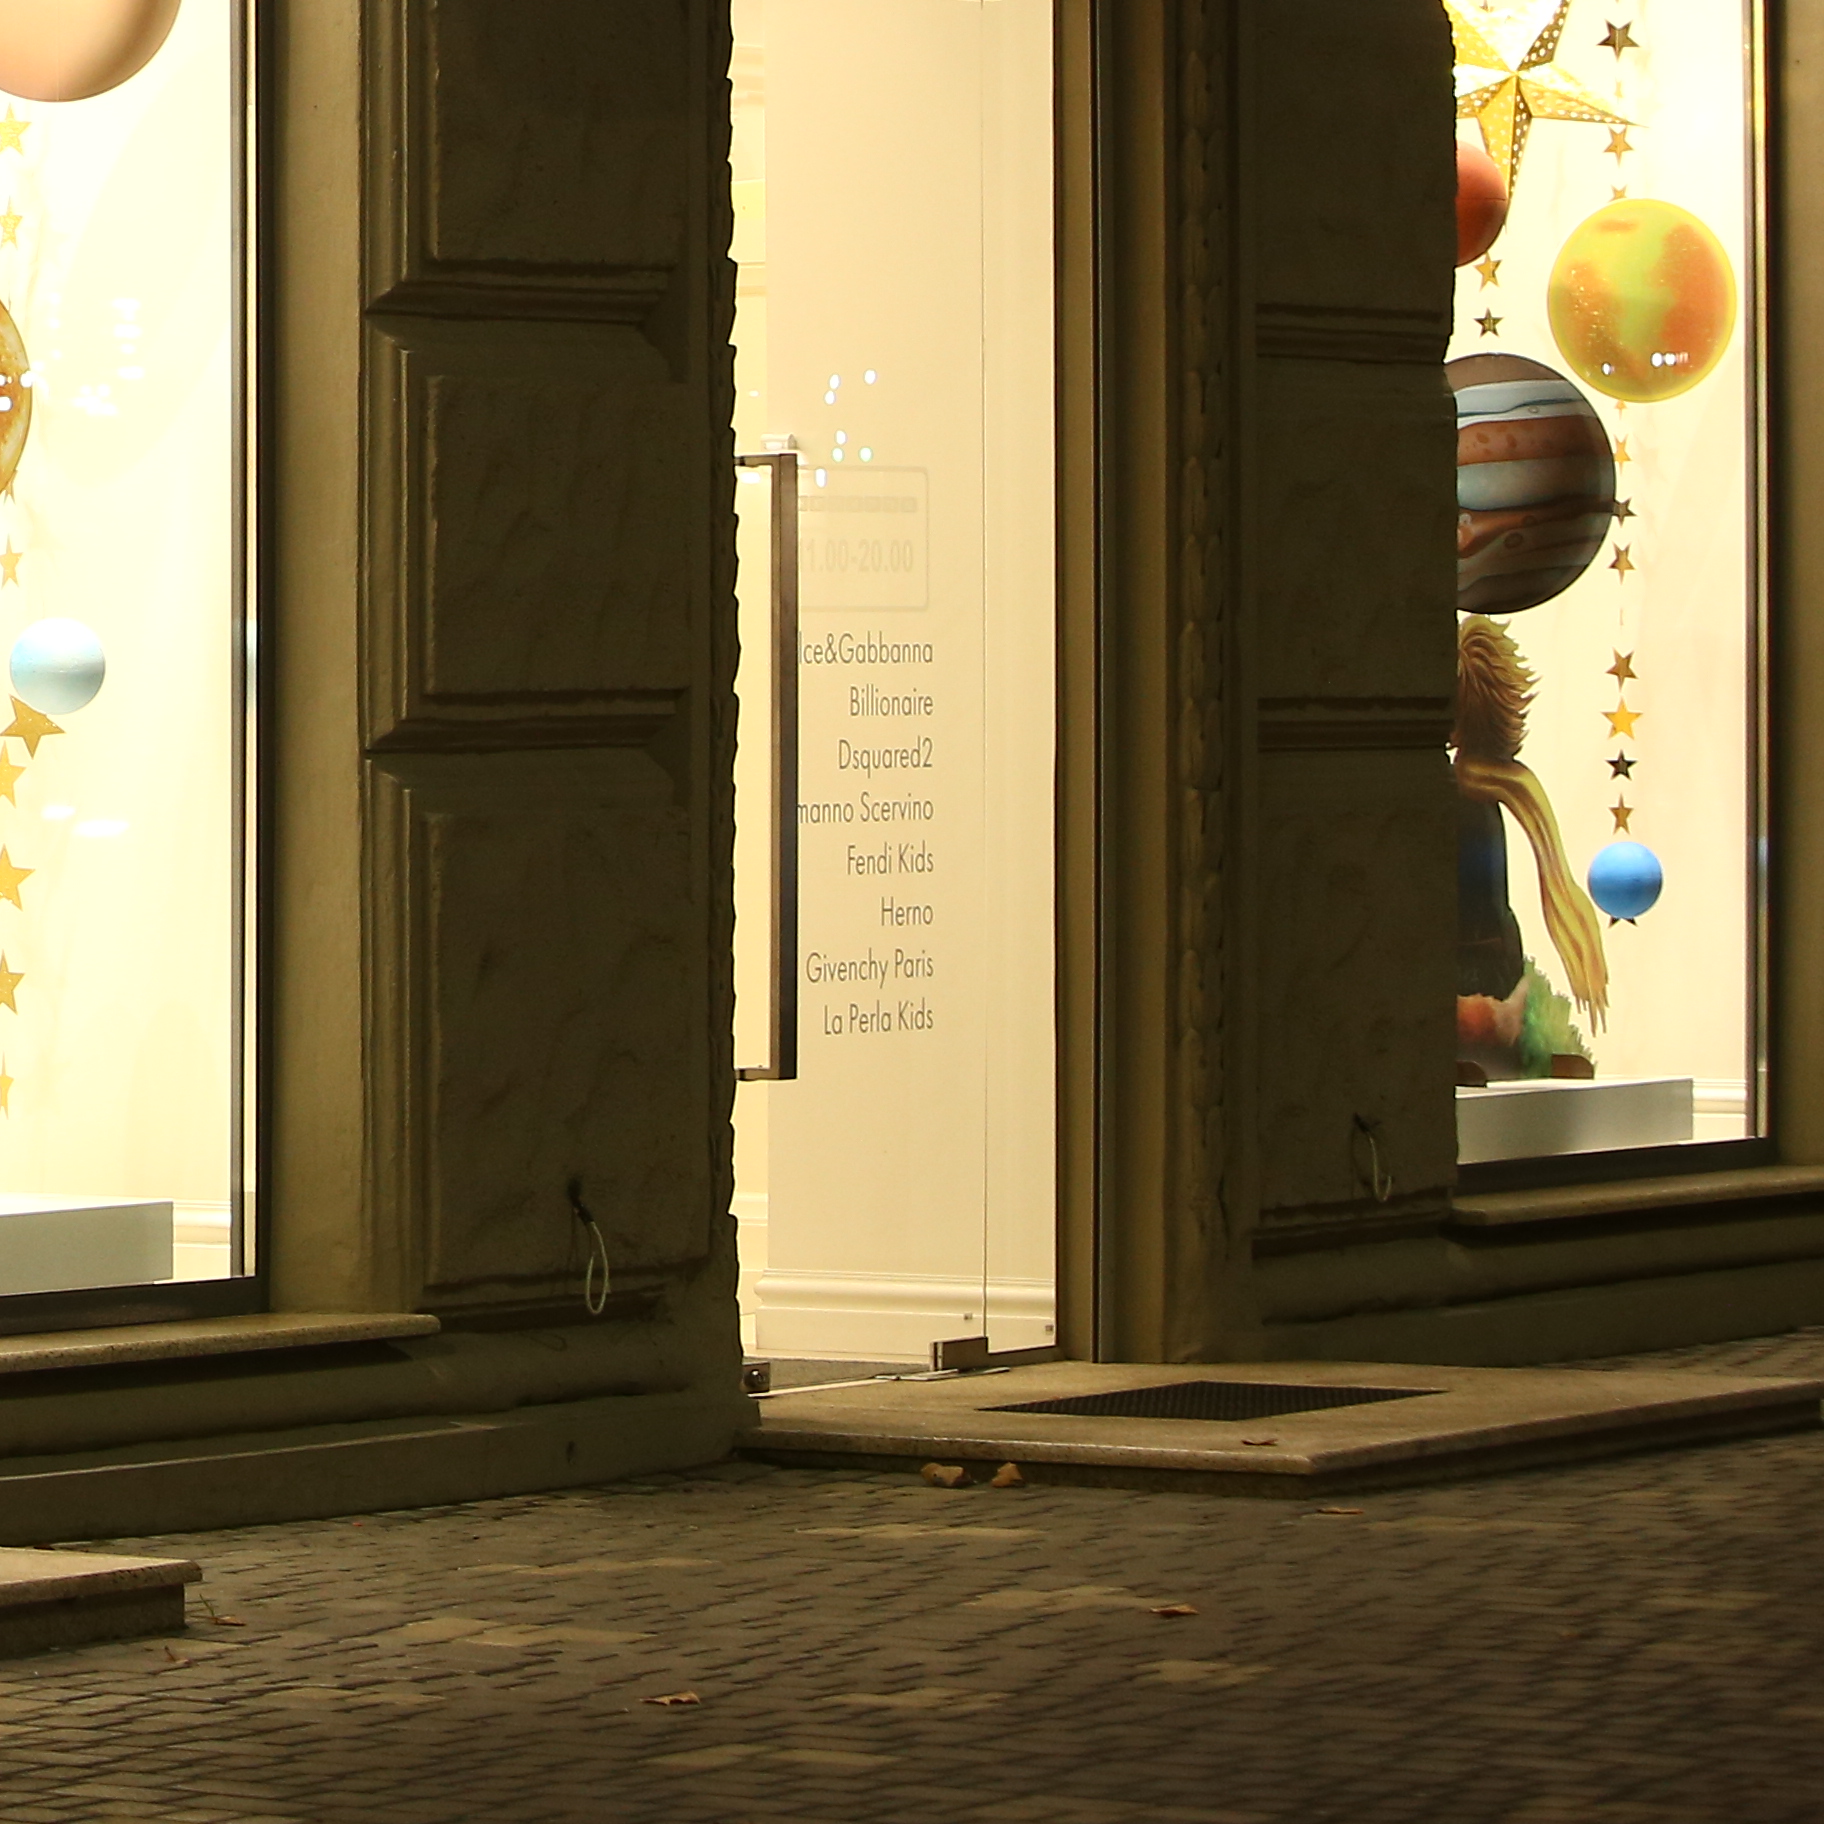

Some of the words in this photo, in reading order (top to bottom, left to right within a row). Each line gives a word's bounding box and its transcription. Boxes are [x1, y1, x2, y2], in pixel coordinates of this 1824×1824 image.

[850, 683, 933, 717] Billionaire
[838, 735, 933, 779] Dsquared2
[860, 791, 934, 822] Scervino
[847, 841, 892, 875] Fendi
[898, 839, 934, 874] Kids
[881, 896, 933, 927] Herno
[806, 947, 889, 989] Givenchy
[895, 947, 934, 978] Paris
[824, 1005, 842, 1035] La
[849, 999, 891, 1034] Perla
[898, 997, 934, 1031] Kids
